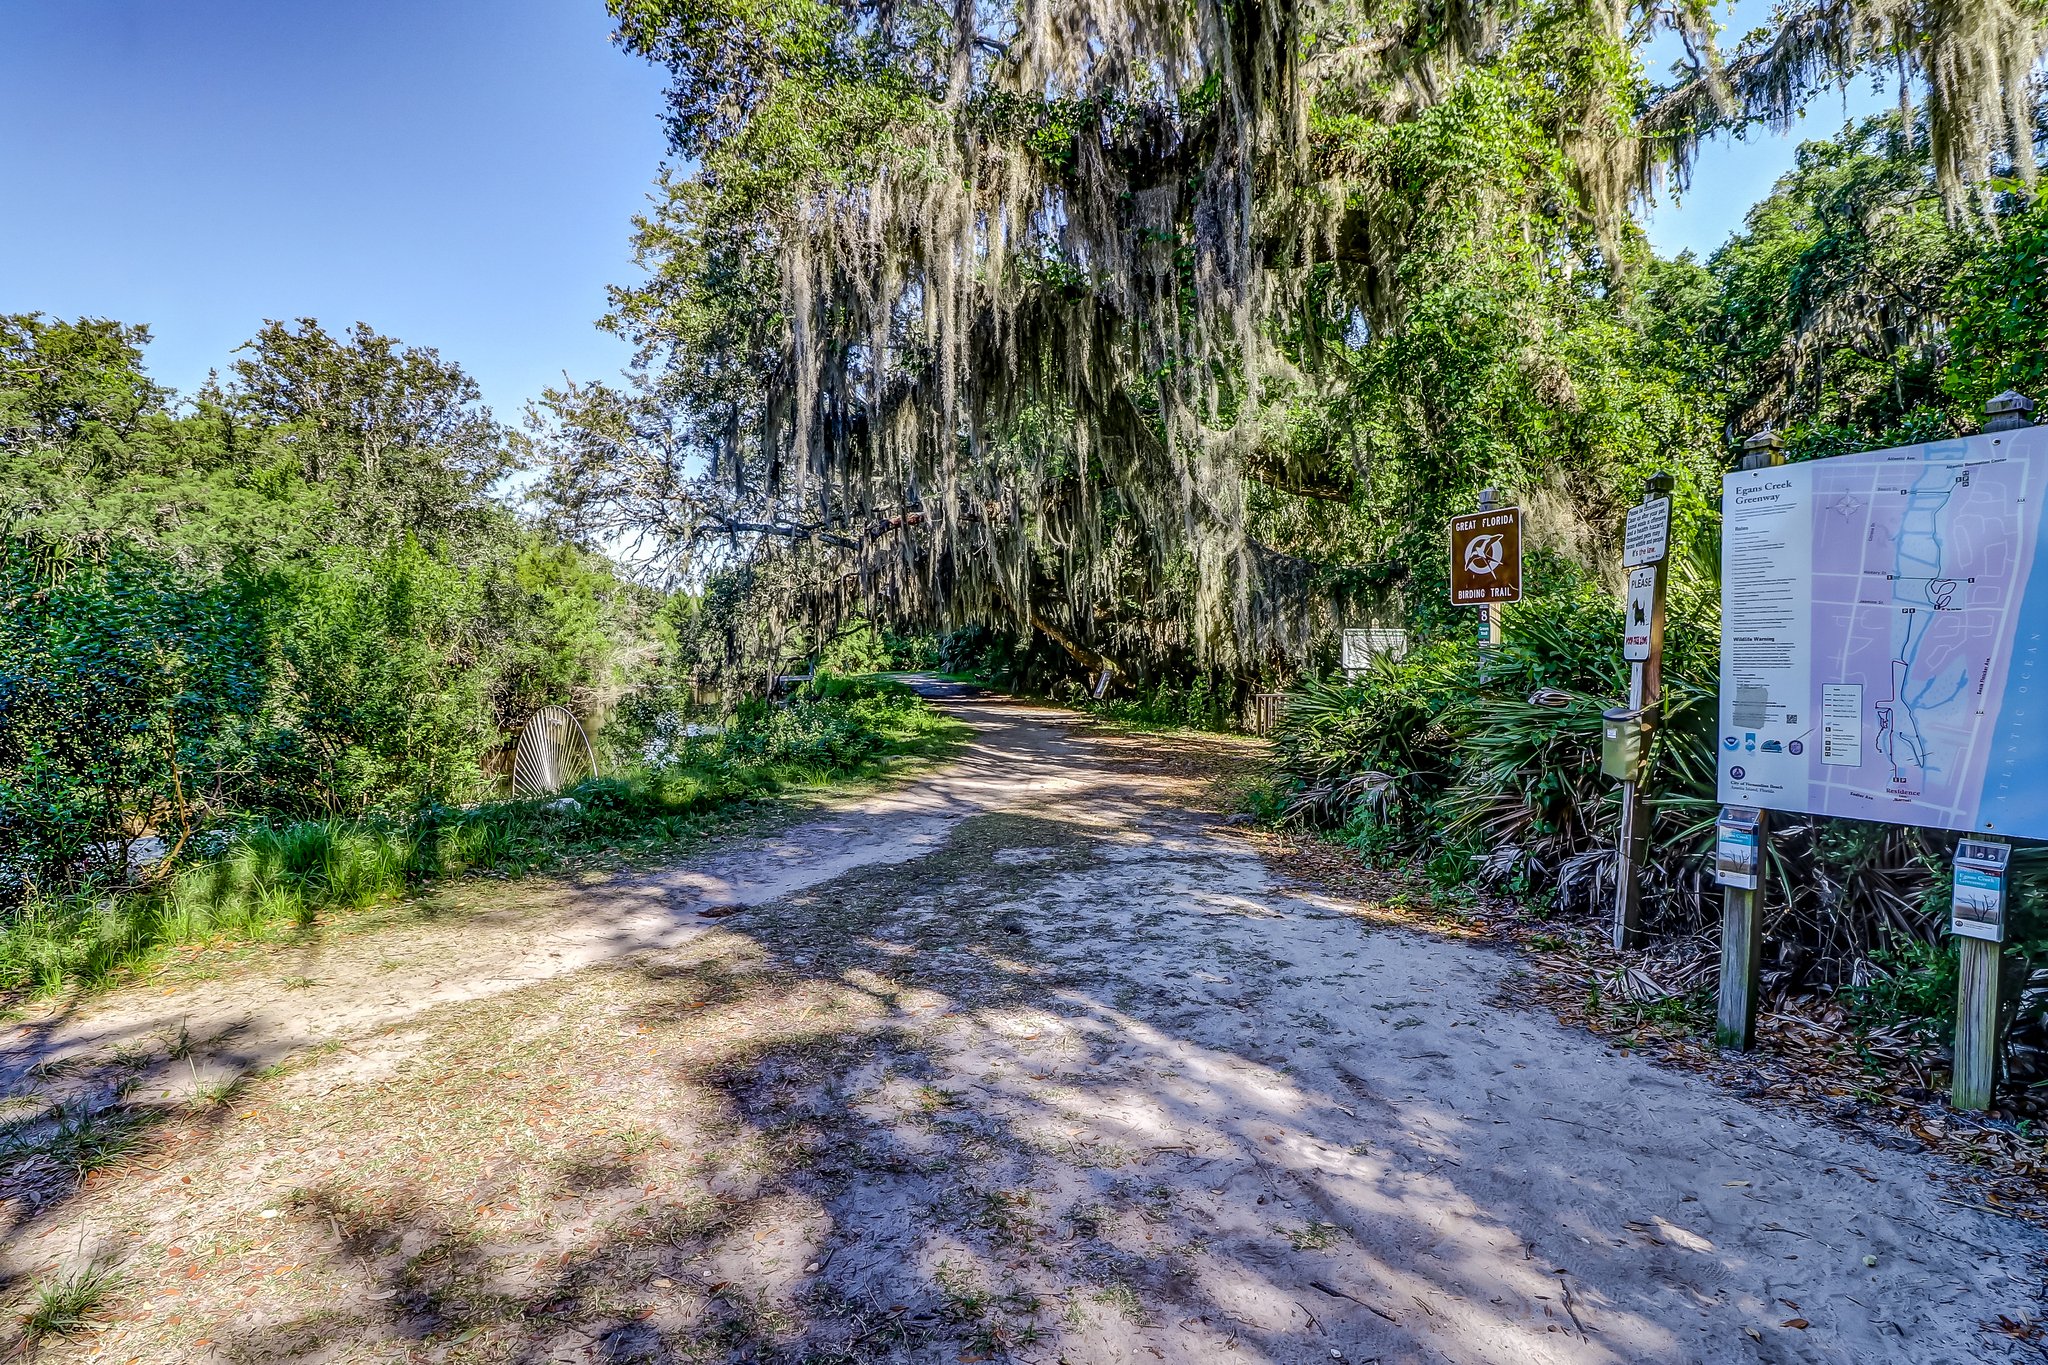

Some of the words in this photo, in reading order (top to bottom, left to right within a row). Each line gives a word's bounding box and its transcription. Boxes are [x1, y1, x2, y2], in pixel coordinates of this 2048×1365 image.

[1946, 462, 1963, 470] Atlantic
[1964, 459, 1990, 468] Recreation
[1735, 486, 1763, 497] Egans
[1764, 480, 1792, 491] Creek
[1735, 494, 1780, 505] Greenway
[1456, 520, 1476, 531] GREAT
[1482, 514, 1513, 528] FLORIDA
[1632, 577, 1652, 589] PLEASE
[1458, 588, 1486, 600] BIRDING
[1490, 587, 1512, 598] TRAIL
[1481, 610, 1488, 622] 8
[1997, 710, 2025, 802] ATLANTIC
[2019, 633, 2041, 694] OCEAN
[1886, 787, 1921, 797] Residence
